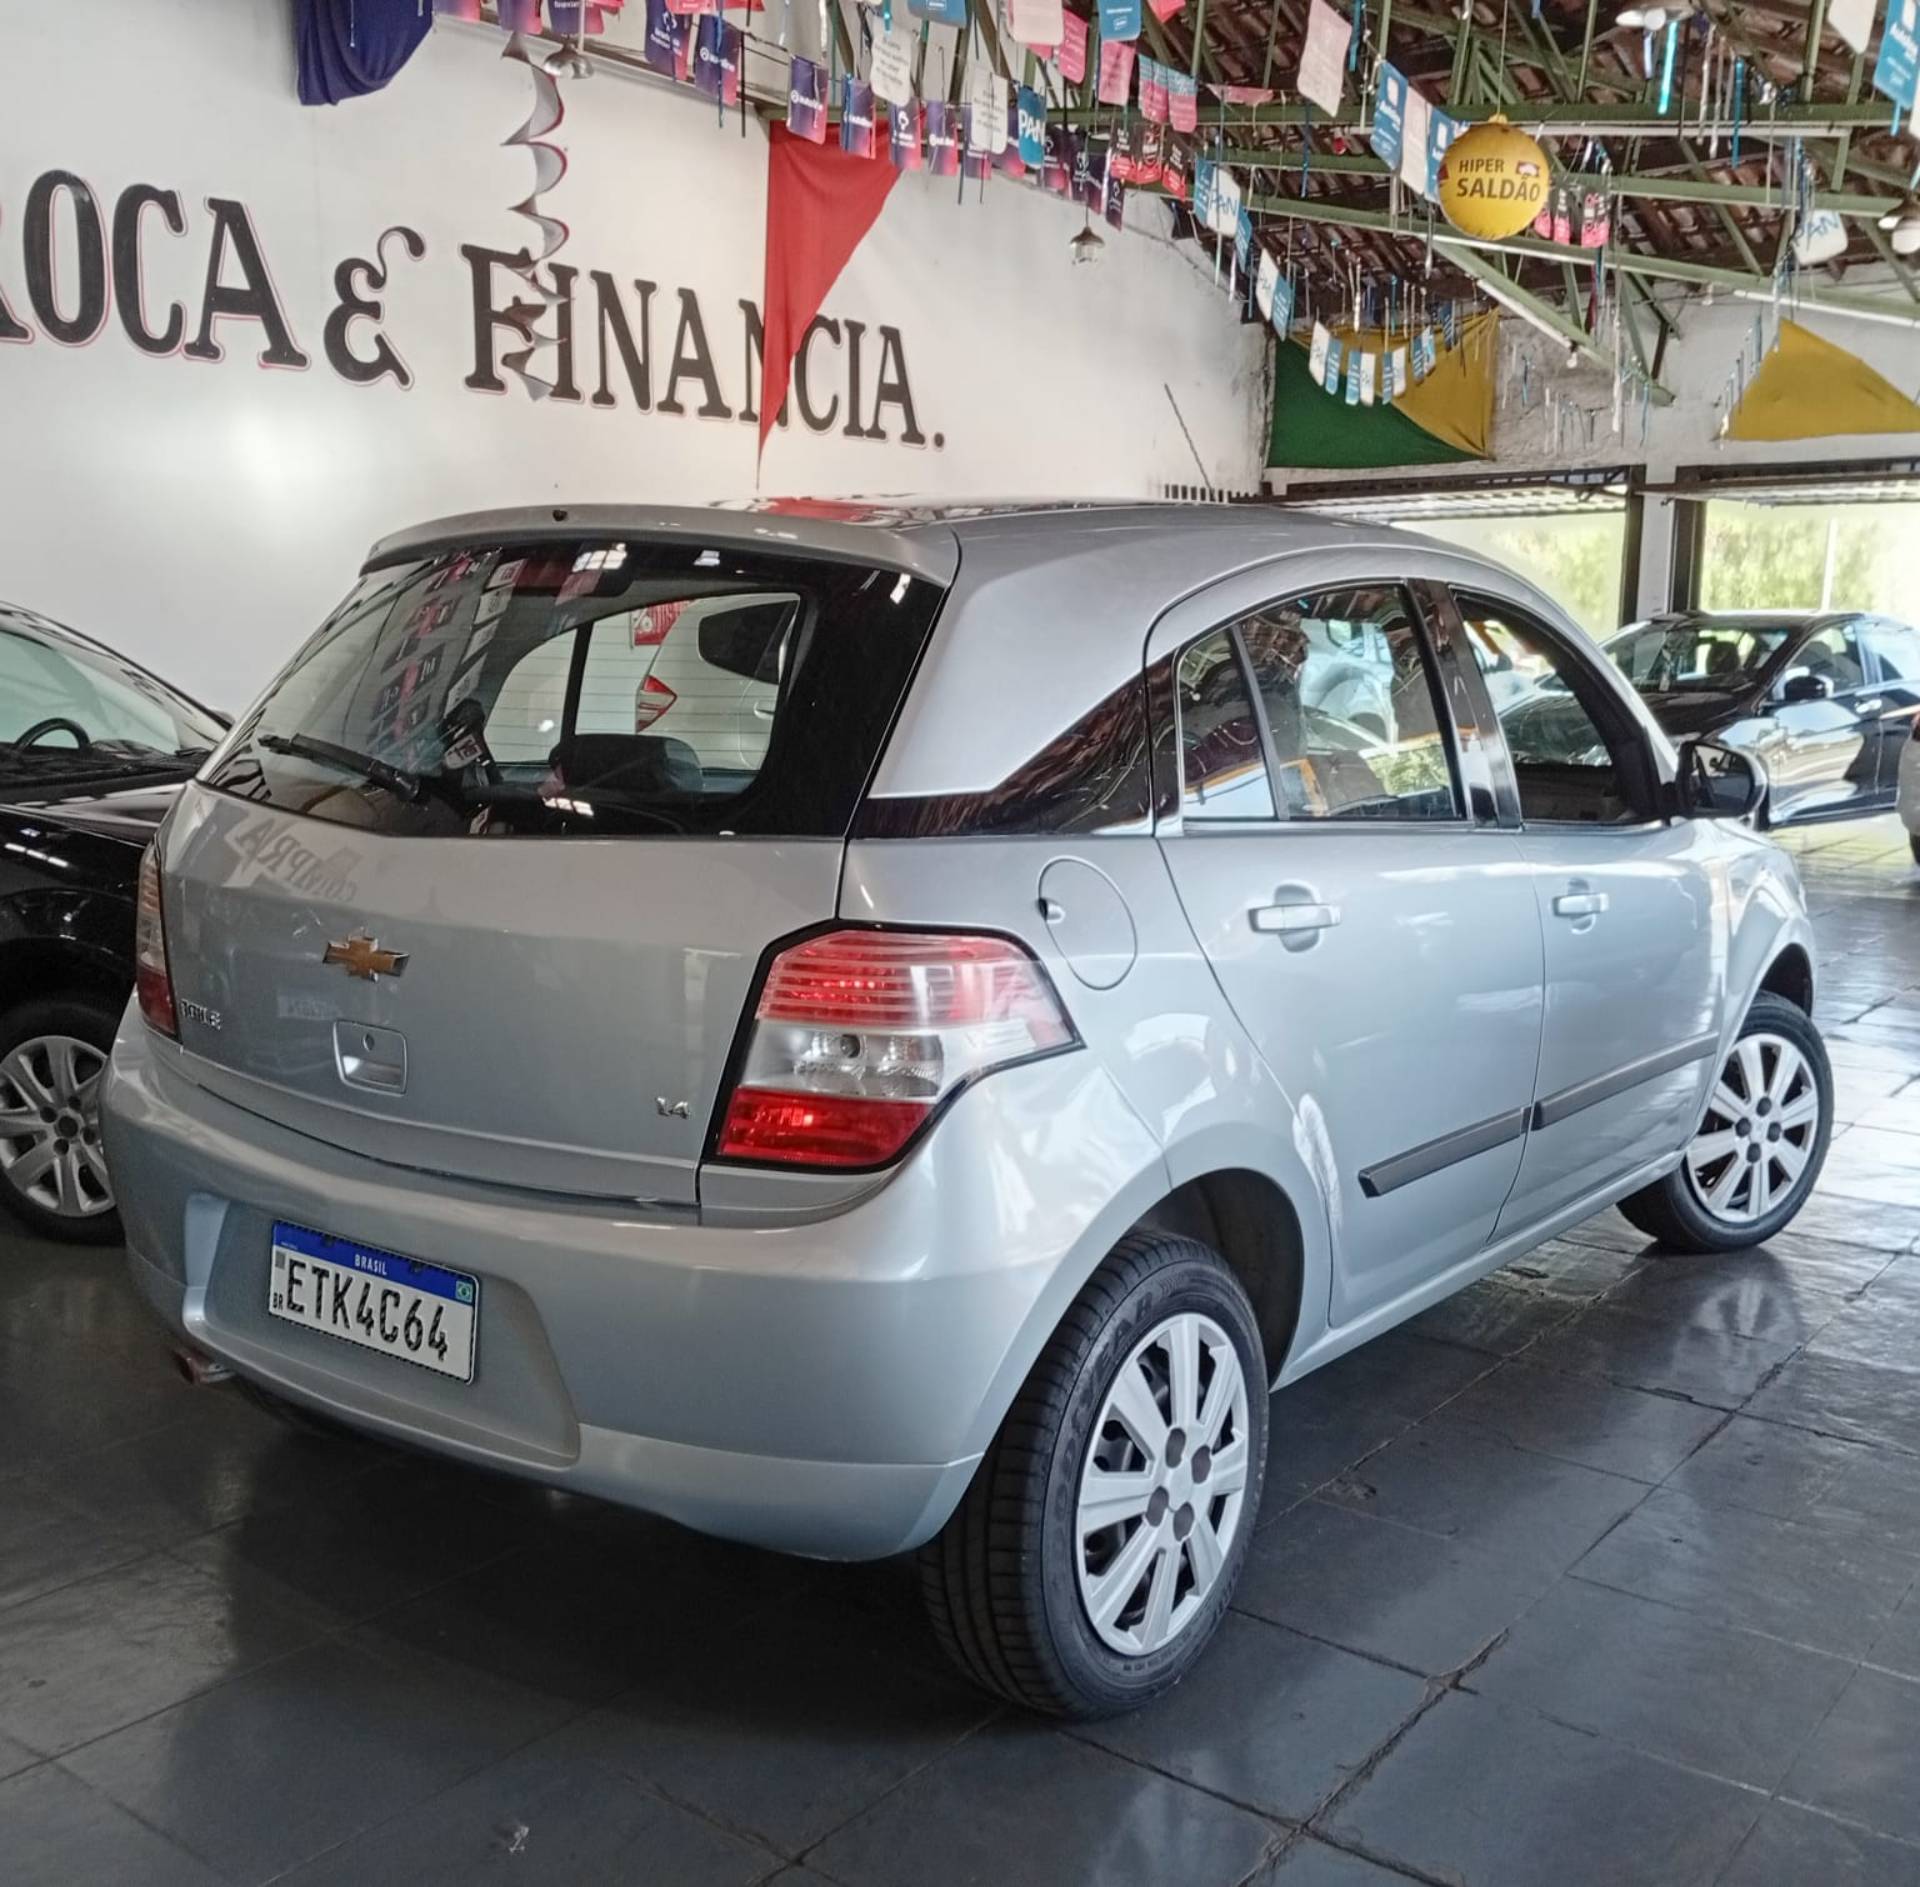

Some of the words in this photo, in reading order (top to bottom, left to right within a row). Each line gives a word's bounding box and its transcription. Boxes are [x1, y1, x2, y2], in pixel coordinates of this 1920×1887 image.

[1019, 109, 1046, 144] PAN
[1459, 158, 1505, 174] HIPER
[1456, 174, 1541, 202] SALDÃO
[323, 226, 426, 388] &
[354, 1253, 388, 1276] BRASIL
[272, 1291, 284, 1312] BR
[286, 1258, 449, 1362] ETK4C64
